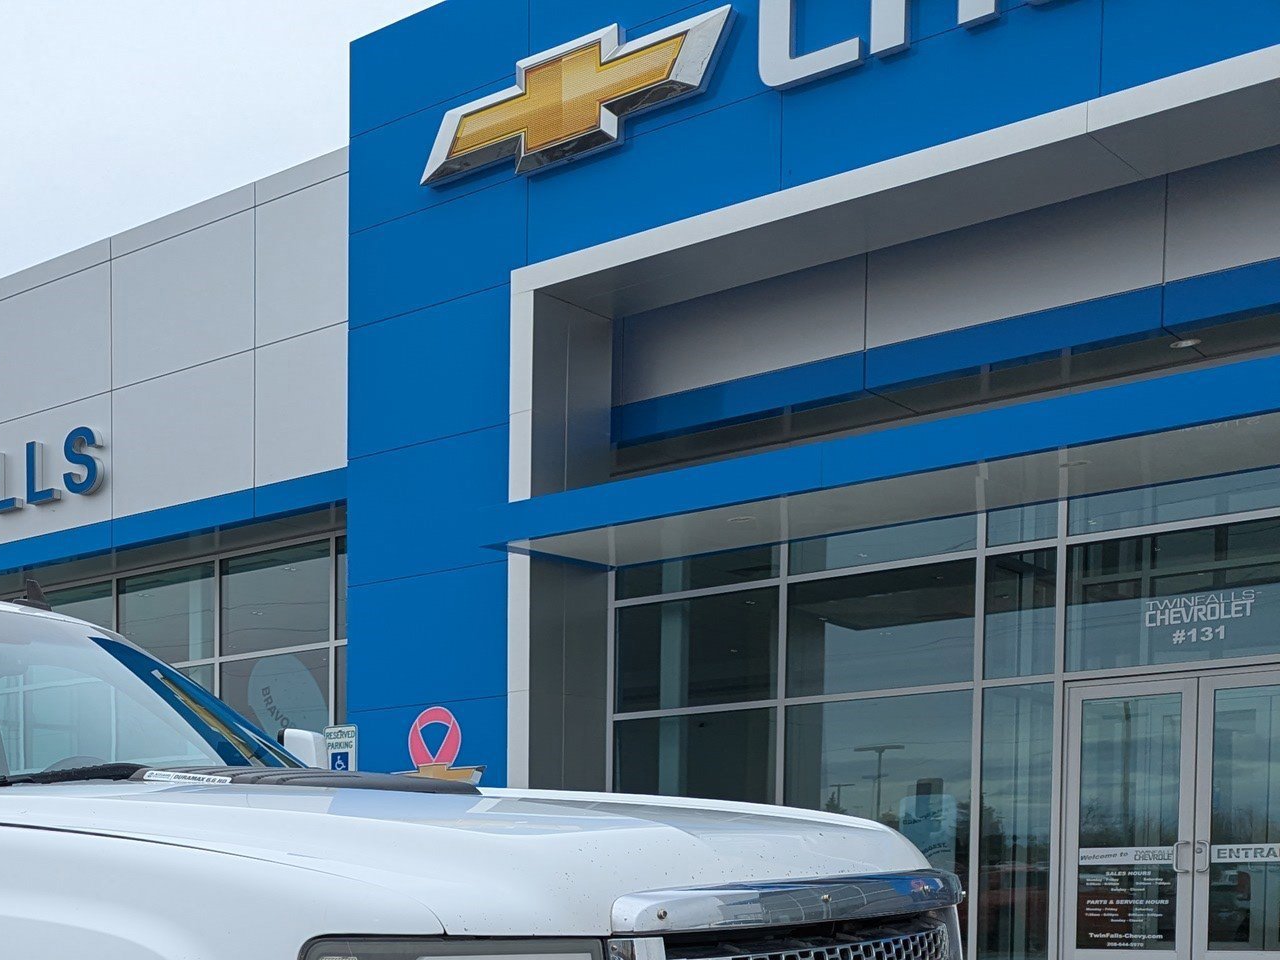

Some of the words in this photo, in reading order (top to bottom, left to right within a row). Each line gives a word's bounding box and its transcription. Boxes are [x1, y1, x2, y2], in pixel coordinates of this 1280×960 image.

[1145, 600, 1255, 627] CHEVROLET
[1172, 625, 1226, 645] #131
[325, 730, 356, 740] RESERVED
[327, 741, 354, 750] PARKING
[173, 774, 206, 783] DURAMAX
[1080, 853, 1118, 861] Welcome
[1134, 853, 1173, 861] CHEVROLE
[1216, 847, 1280, 859] ENTRA
[1089, 932, 1164, 940] TwinFalls-Chevy.com
